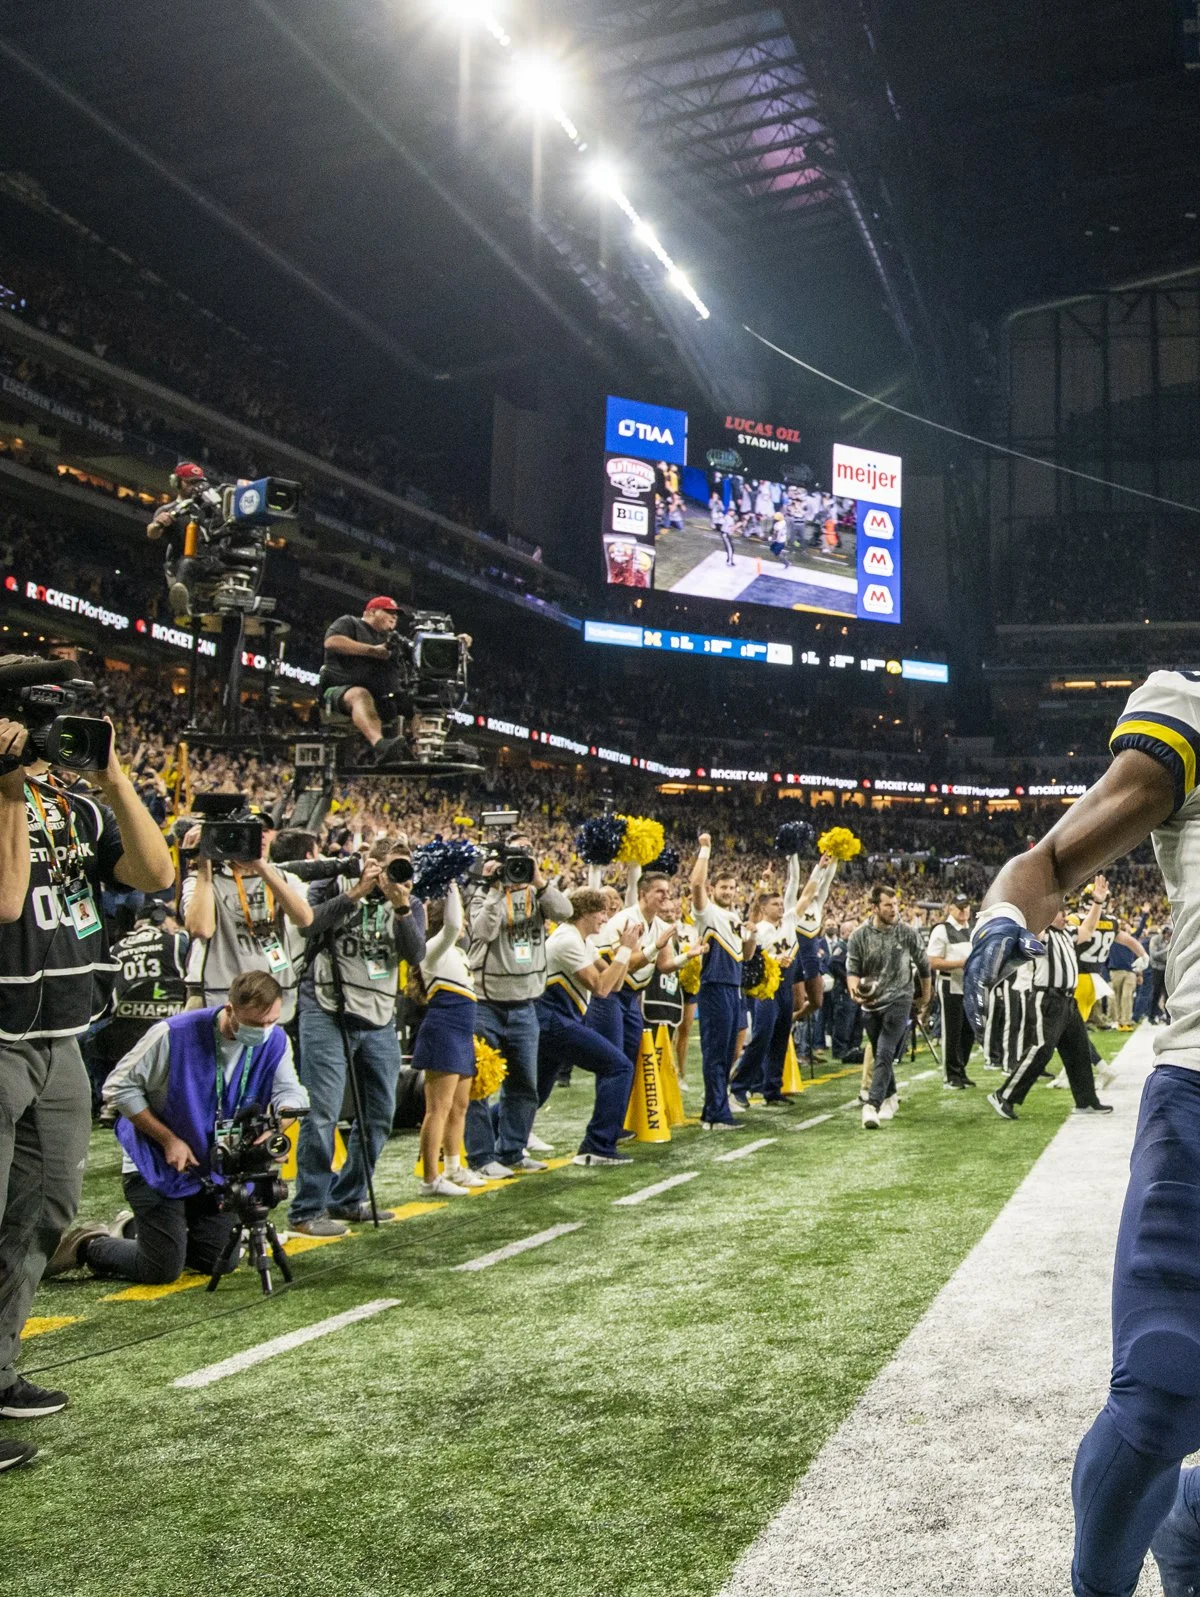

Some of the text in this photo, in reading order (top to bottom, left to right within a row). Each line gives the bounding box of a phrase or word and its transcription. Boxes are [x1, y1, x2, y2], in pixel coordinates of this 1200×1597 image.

[635, 422, 674, 446] TIAA
[725, 416, 801, 443] LUCAS OIL
[737, 433, 789, 453] STADIUM
[837, 463, 897, 490] meijer
[26, 582, 129, 629] ROCKET Mortgage
[151, 623, 194, 650] ROCKET
[487, 718, 515, 735] ROCKET
[711, 768, 768, 782] ROCKET CAN
[787, 774, 858, 789] ROCKET Mortgage
[875, 780, 925, 792] ROCKET CAN
[942, 784, 1010, 798] ROCKET Mortgage
[1029, 785, 1087, 795] ROCKET CAN
[1079, 932, 1116, 963] 28
[124, 958, 161, 980] 013
[641, 1053, 660, 1130] MICHIGAN
